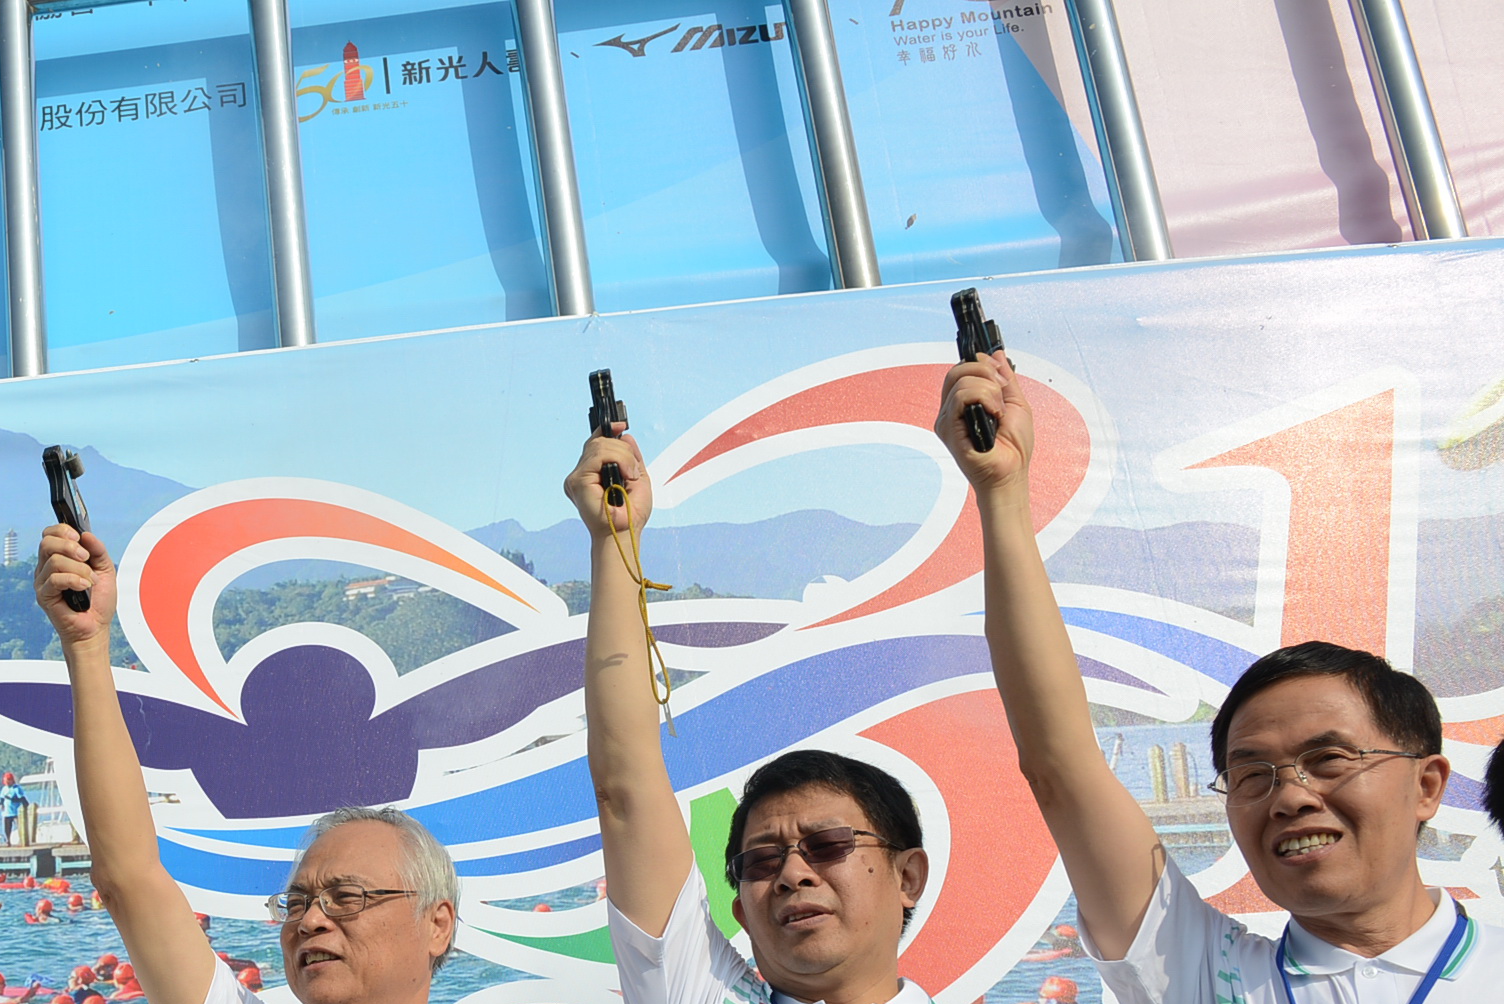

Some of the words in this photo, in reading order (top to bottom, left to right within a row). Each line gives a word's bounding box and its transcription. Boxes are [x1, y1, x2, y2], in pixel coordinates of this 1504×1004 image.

[891, 16, 953, 32] Happy
[960, 3, 1053, 25] Mountain
[671, 23, 787, 53] MIZU
[893, 33, 936, 47] Water
[941, 31, 953, 42] is
[957, 28, 989, 42] your
[994, 23, 1025, 36] Life.
[897, 41, 982, 66] 幸福好水
